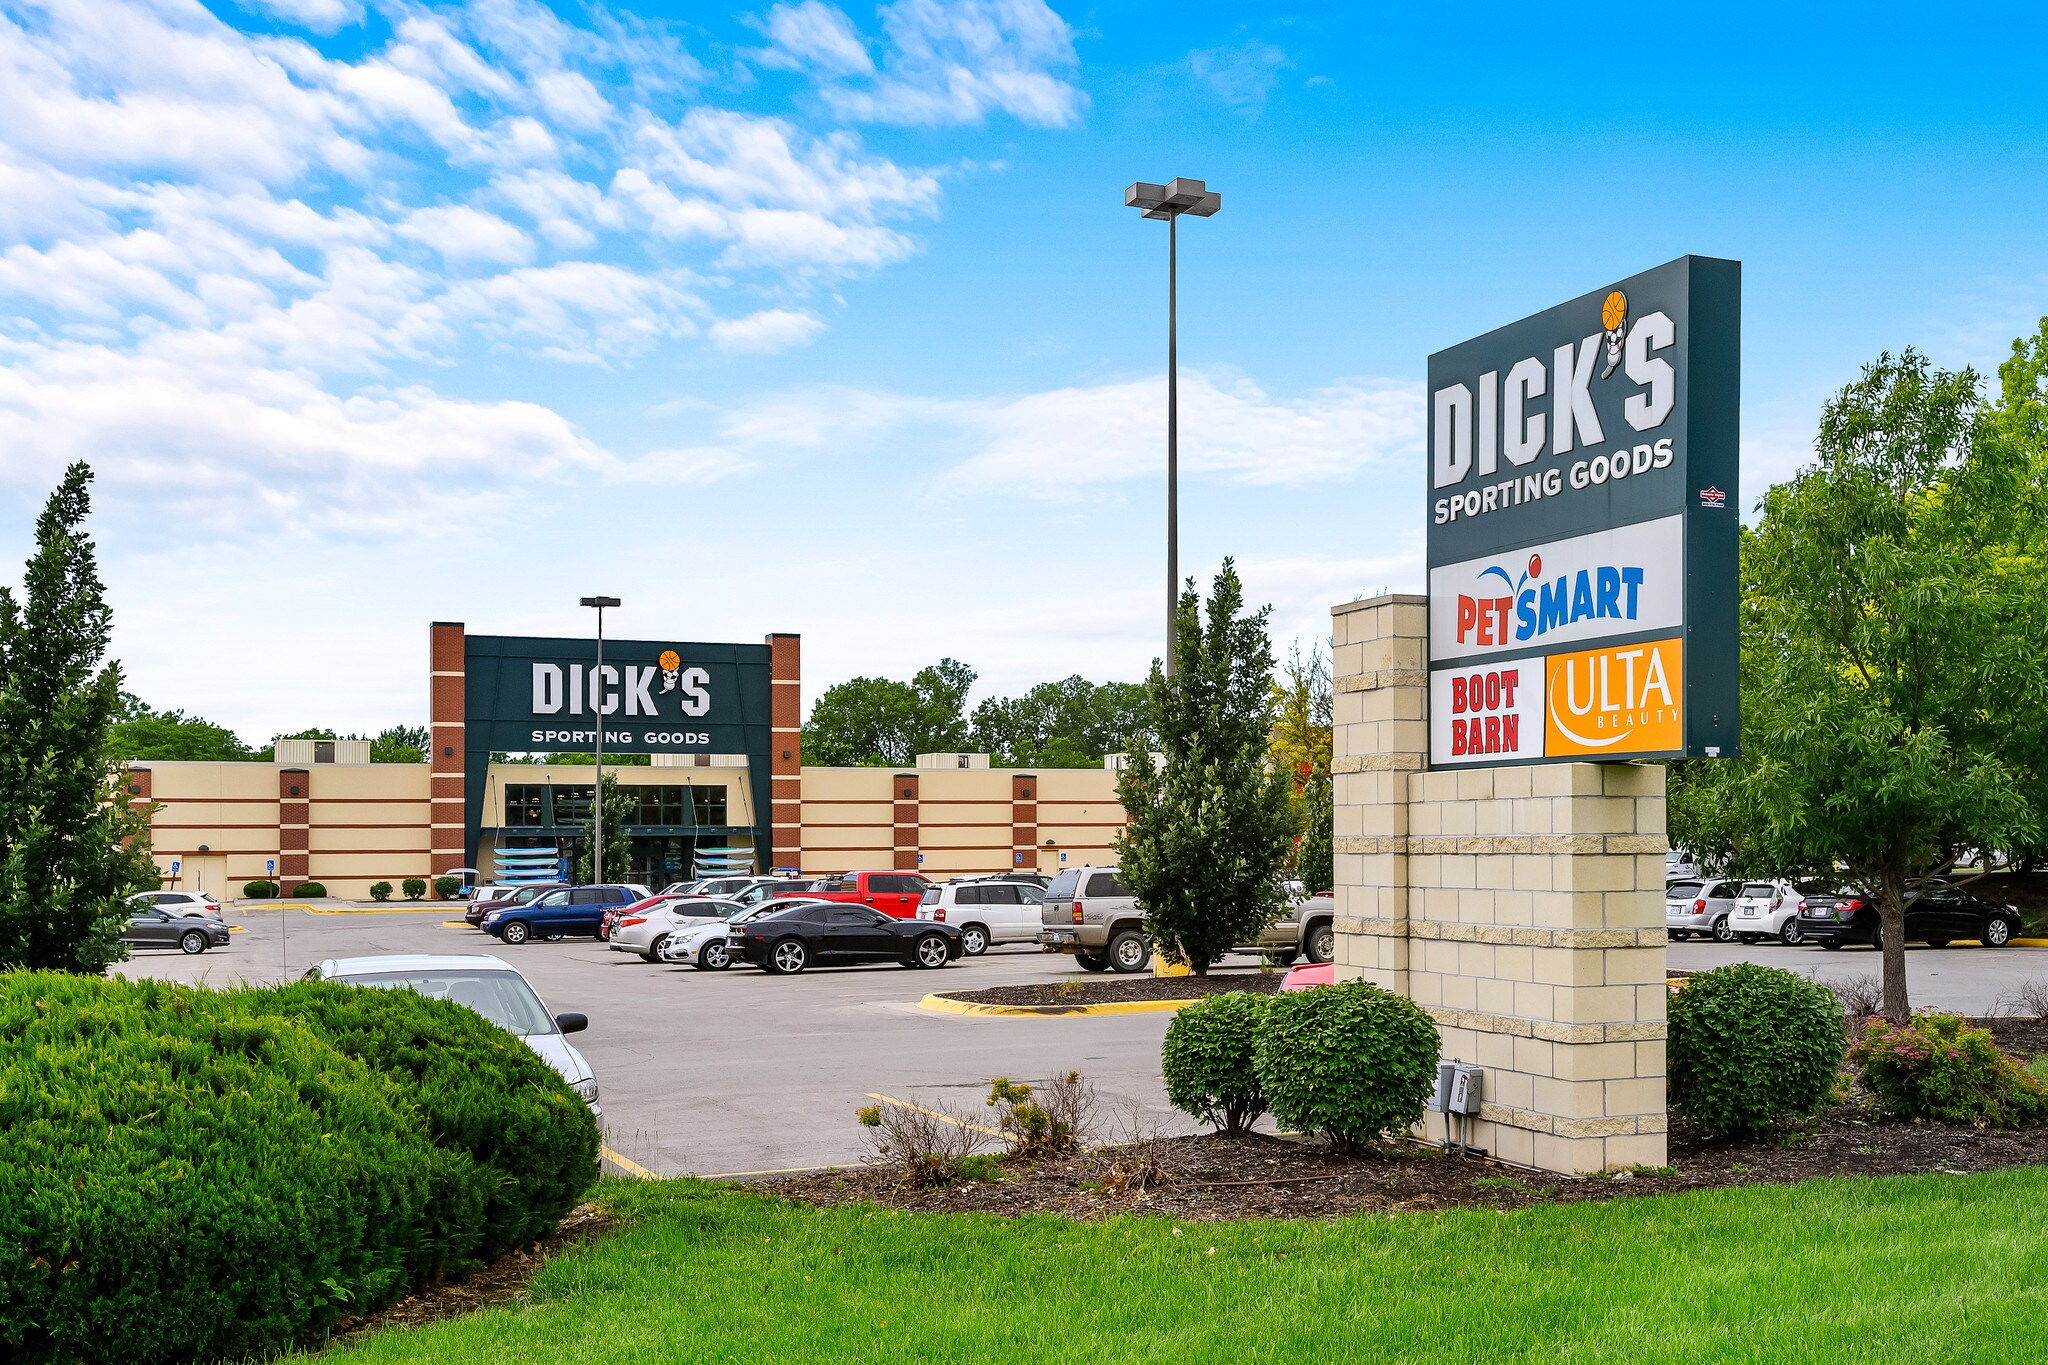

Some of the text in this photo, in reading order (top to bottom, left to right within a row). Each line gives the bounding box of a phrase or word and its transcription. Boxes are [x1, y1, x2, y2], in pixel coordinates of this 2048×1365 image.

[1434, 290, 1676, 489] DICK'S
[1434, 438, 1674, 525] SPORTING GOODS
[532, 649, 710, 717] DICK'S
[1452, 669, 1519, 714] BOOT
[1566, 647, 1674, 716] ULTA
[644, 732, 709, 745] GOODS
[1452, 714, 1519, 756] BARN
[1597, 708, 1680, 729] BEAUTY
